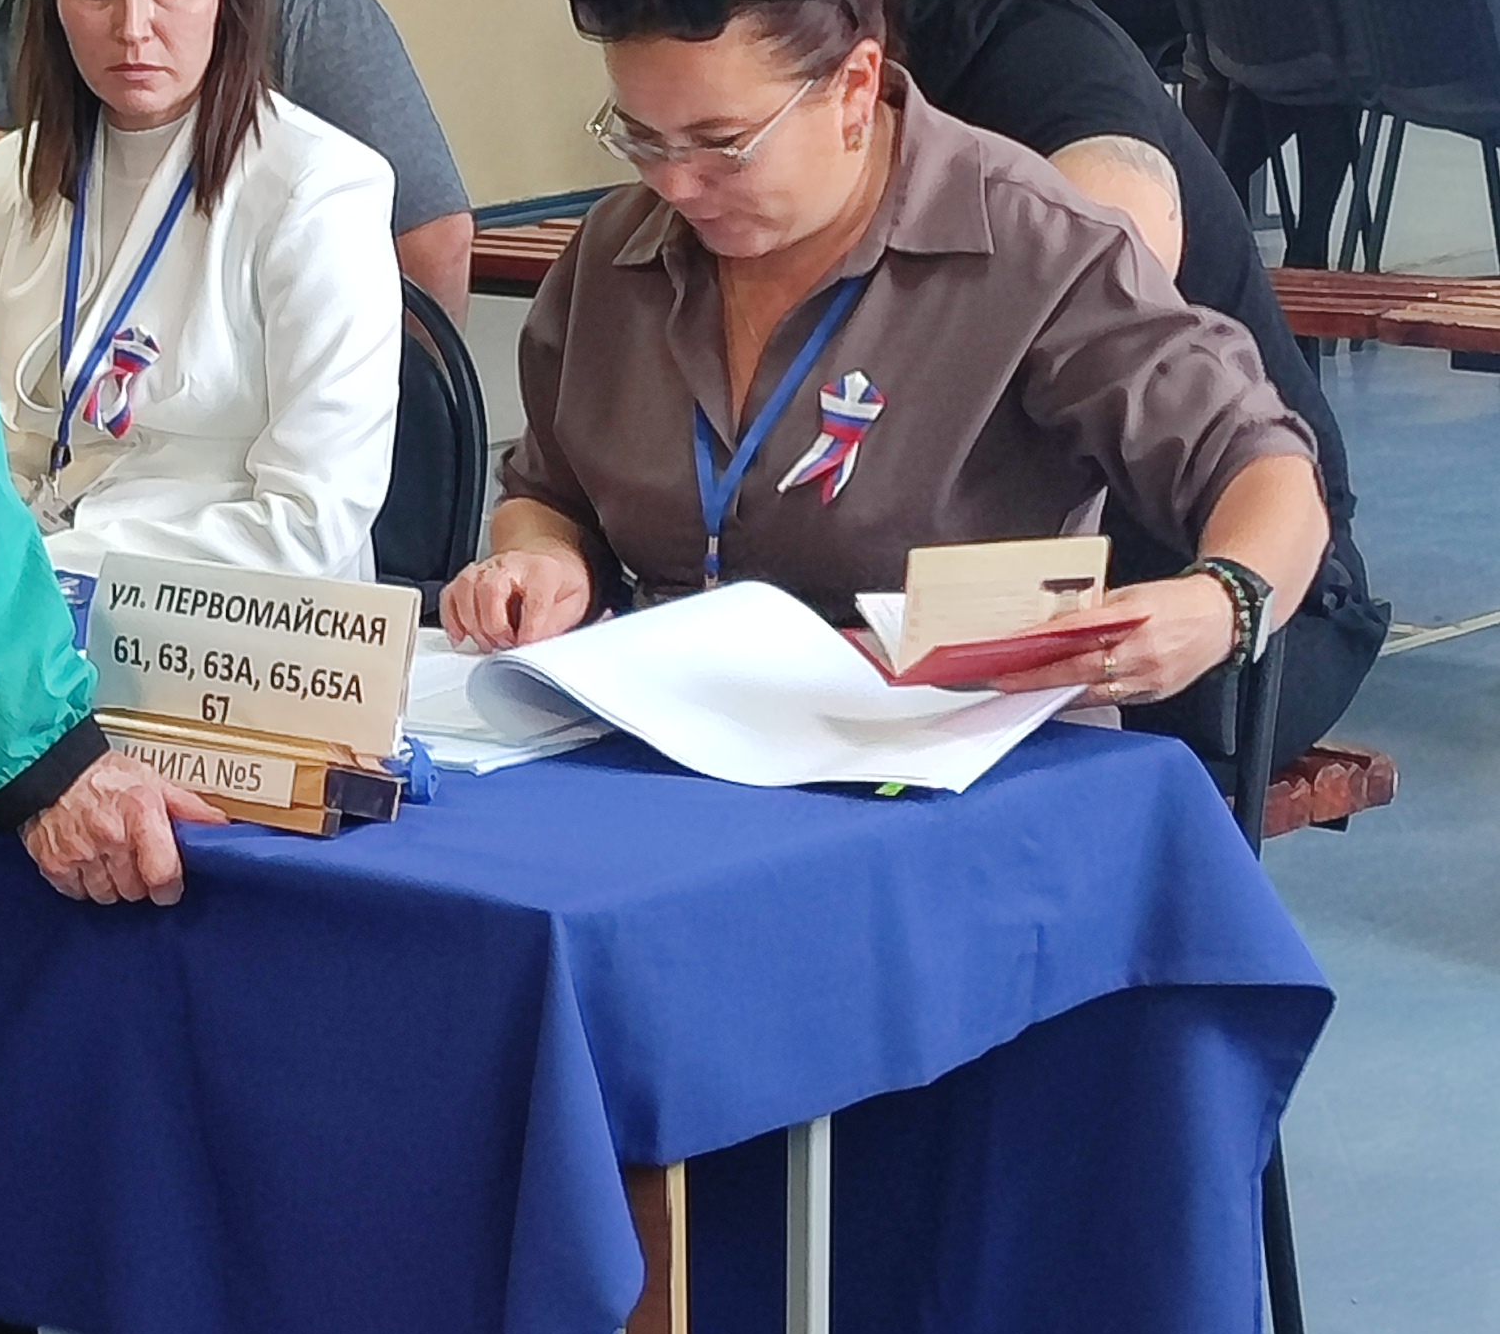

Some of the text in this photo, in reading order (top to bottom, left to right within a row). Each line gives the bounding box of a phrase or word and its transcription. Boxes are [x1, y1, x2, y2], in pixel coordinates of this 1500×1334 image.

[110, 582, 387, 646] ул. ПЕРВОМАЙСКАЯ
[114, 636, 151, 672] 61,
[158, 643, 194, 681] 63,
[203, 650, 260, 691] 63А,
[202, 694, 231, 724] 67
[216, 757, 262, 792] №5
